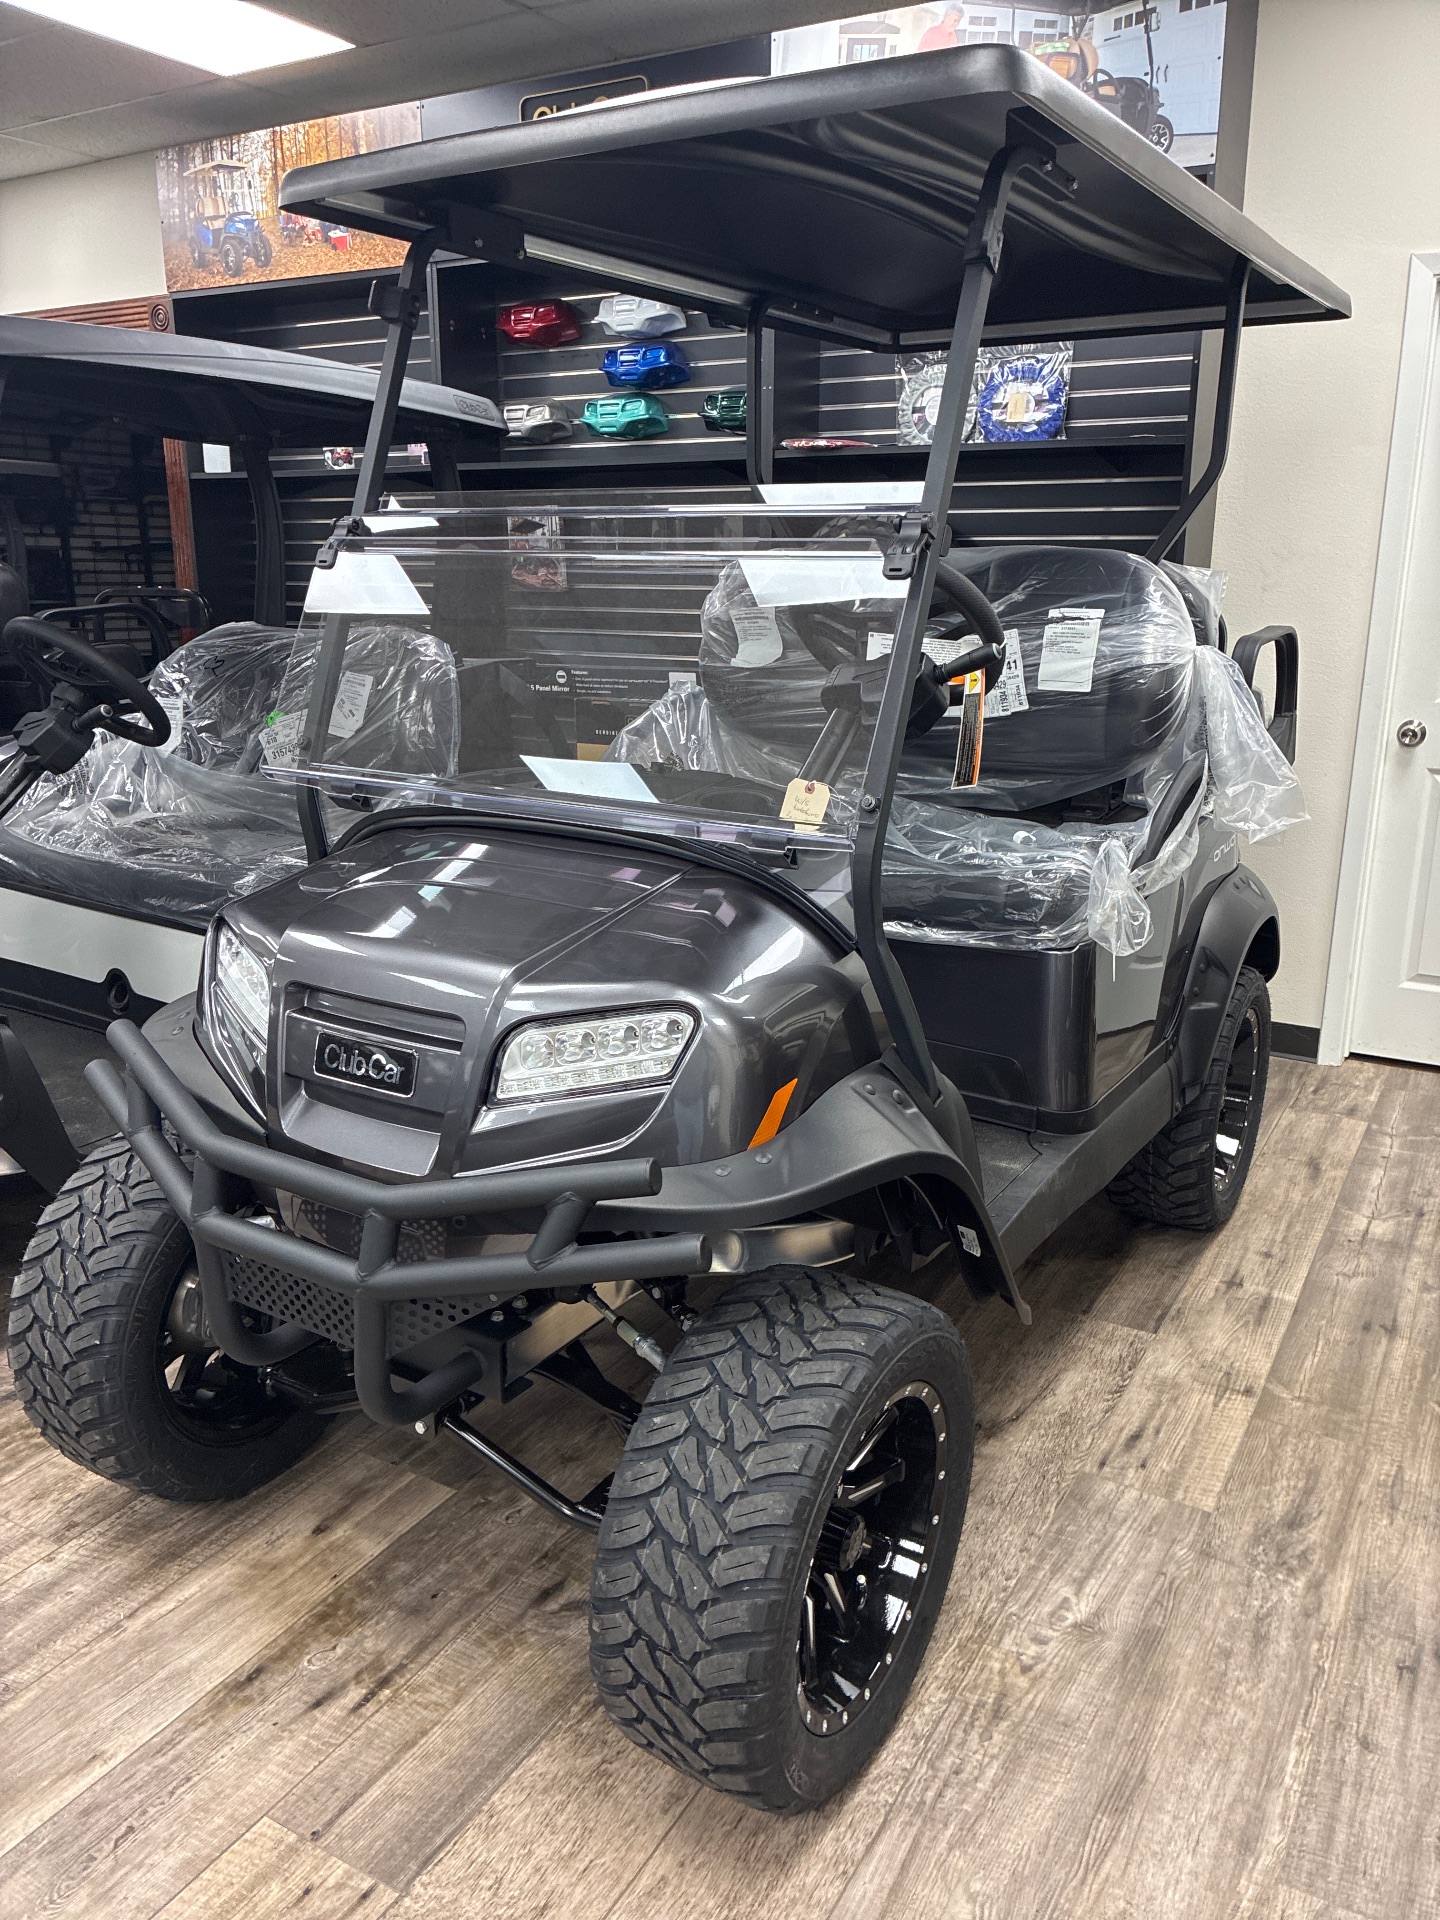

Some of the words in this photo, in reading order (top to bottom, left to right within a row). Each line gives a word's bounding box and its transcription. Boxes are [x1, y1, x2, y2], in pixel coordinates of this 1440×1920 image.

[1006, 659, 1018, 672] 41
[535, 684, 551, 692] Panel
[552, 685, 570, 693] Mirror
[324, 1043, 366, 1076] Club
[368, 1053, 405, 1085] Car
